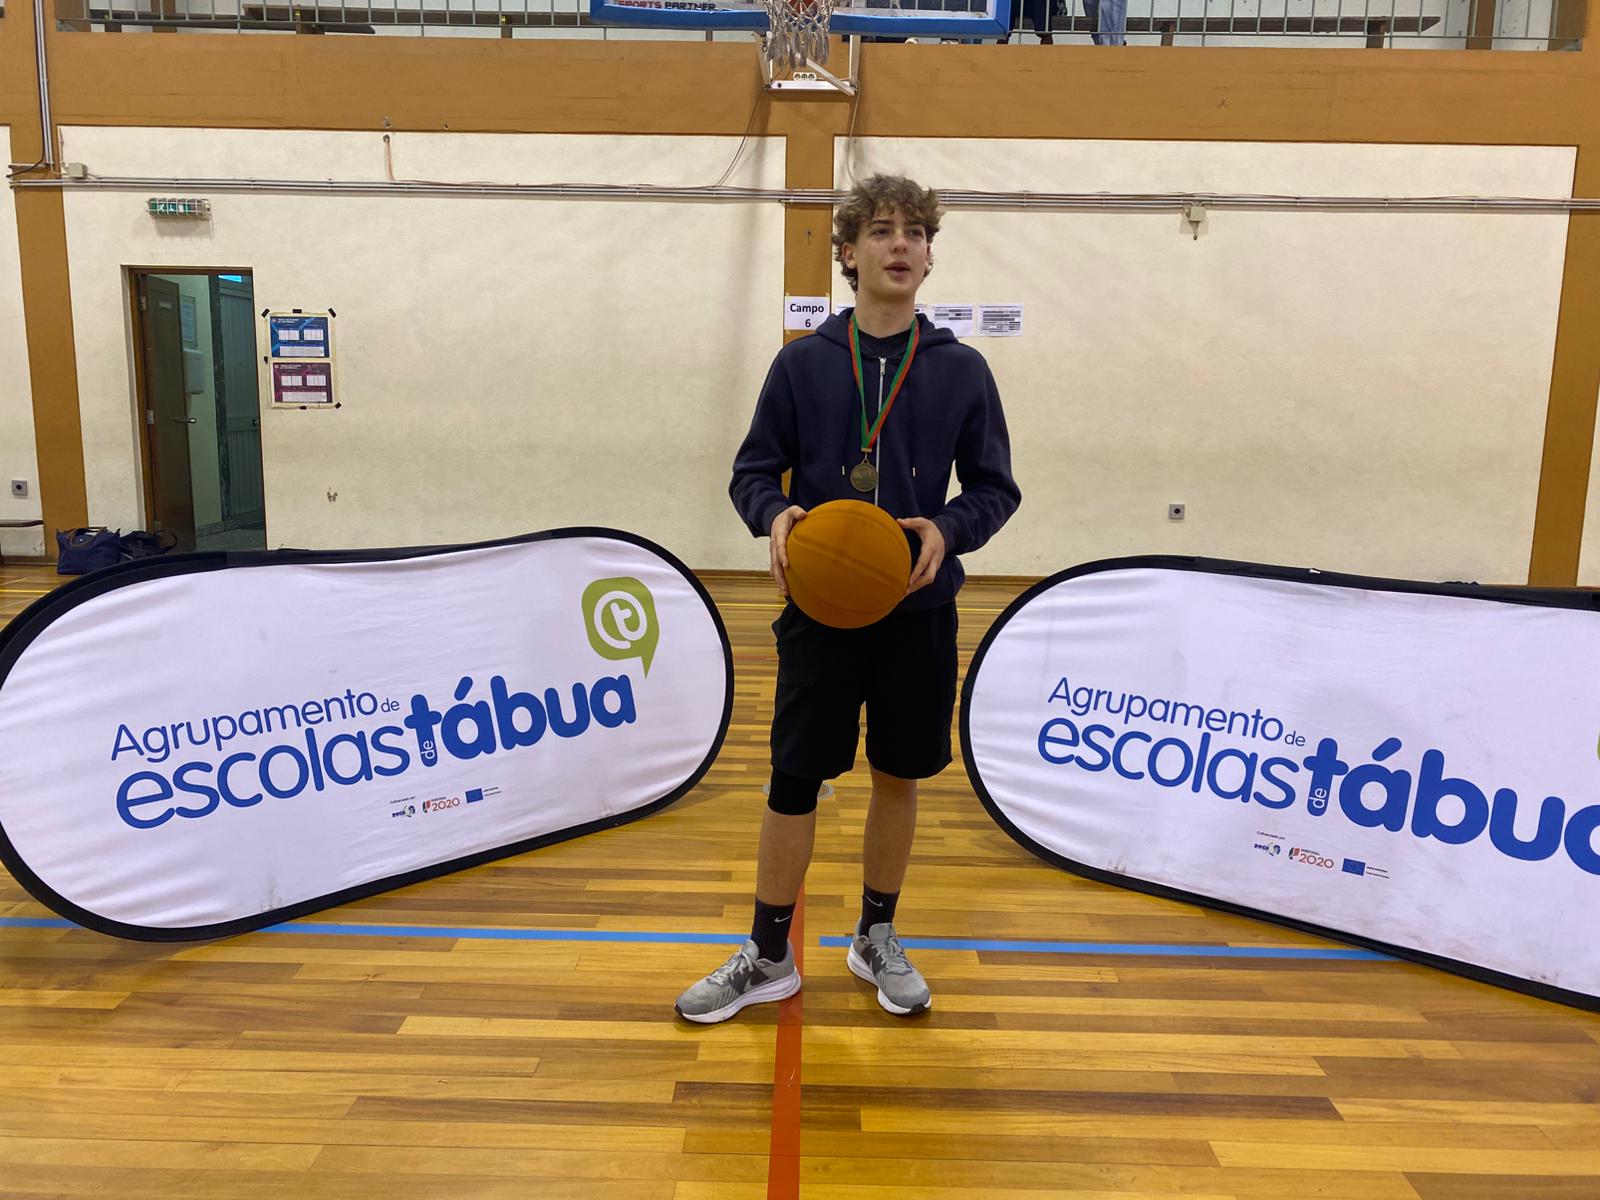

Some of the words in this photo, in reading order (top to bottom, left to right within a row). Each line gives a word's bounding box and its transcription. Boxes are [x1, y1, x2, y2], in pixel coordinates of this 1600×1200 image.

[618, 0, 661, 8] SPORTS
[664, 2, 716, 10] PARTNER
[790, 303, 824, 314] Campo
[805, 319, 811, 328] 6
[403, 675, 636, 768] tábua
[1048, 677, 1284, 742] Agrupamento
[1284, 730, 1306, 746] de
[111, 688, 378, 763] Agrupamento
[380, 697, 400, 713] de
[420, 740, 435, 760] de
[1037, 717, 1300, 810] escolas
[1308, 787, 1327, 809] de
[116, 726, 410, 829] escolas
[432, 797, 460, 812] 2020
[1299, 853, 1334, 869] 2020
